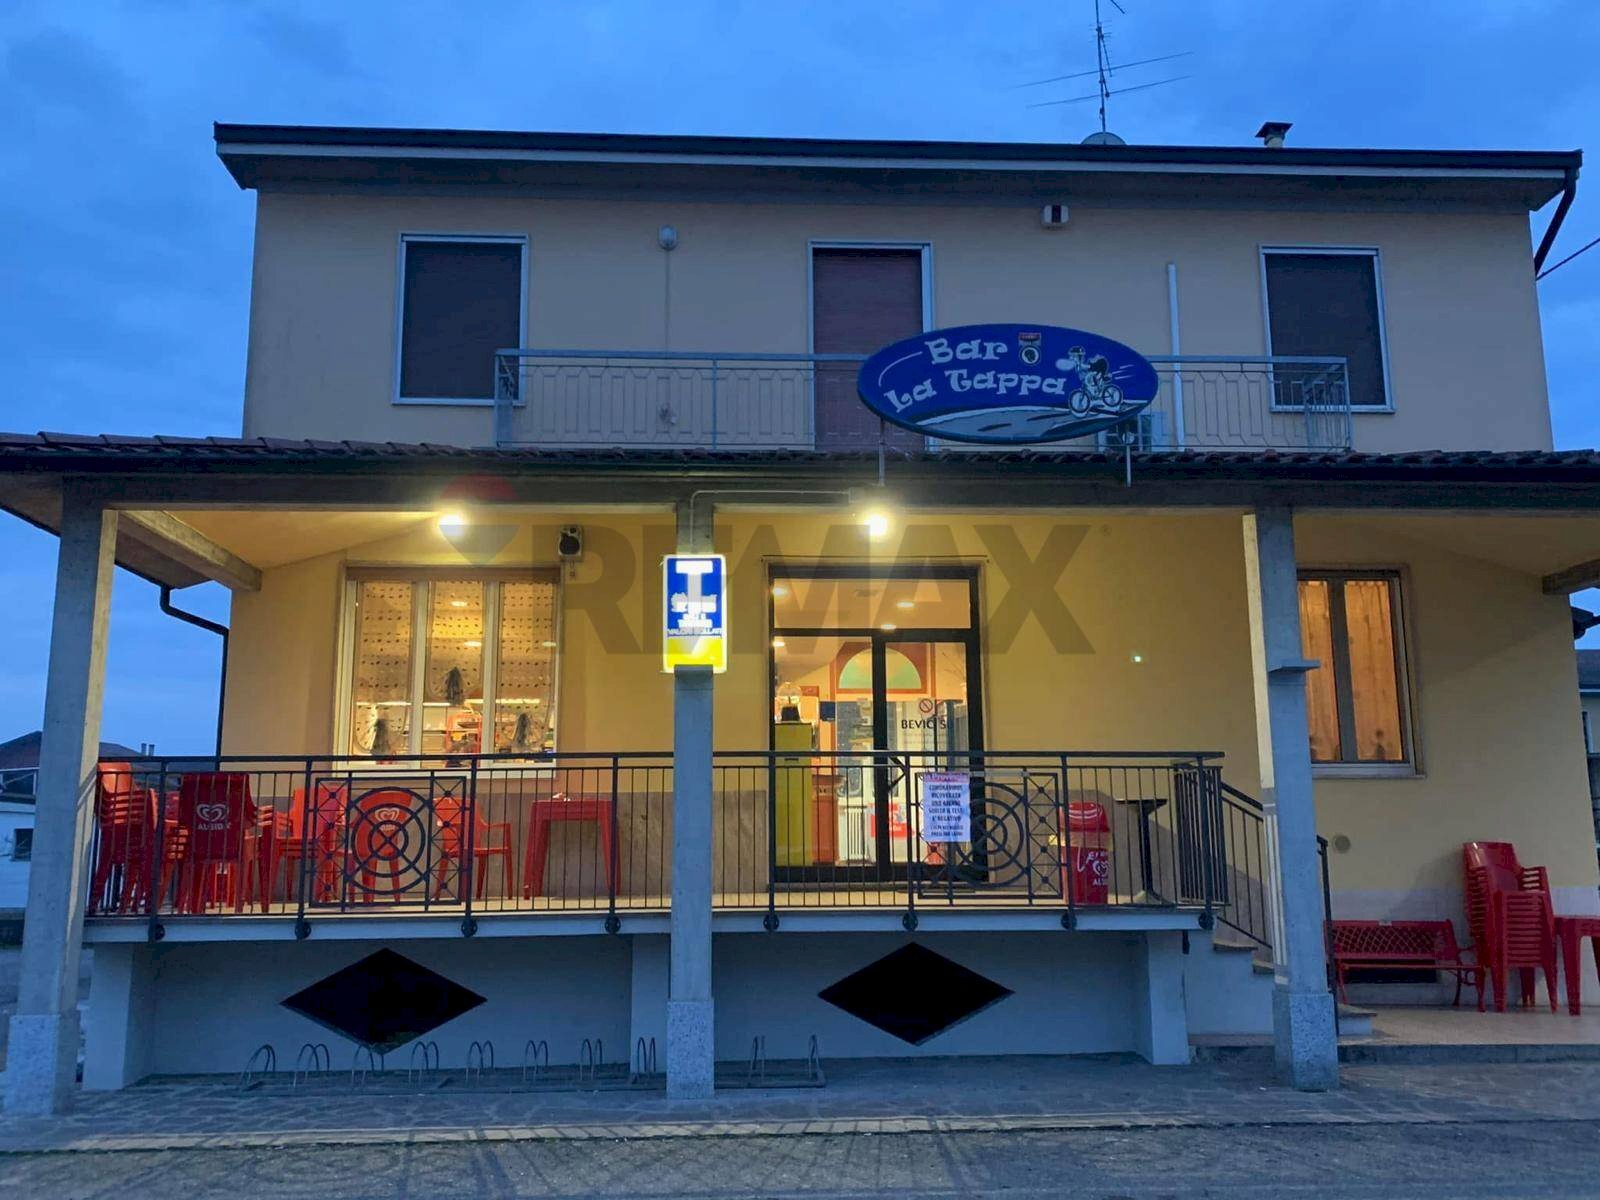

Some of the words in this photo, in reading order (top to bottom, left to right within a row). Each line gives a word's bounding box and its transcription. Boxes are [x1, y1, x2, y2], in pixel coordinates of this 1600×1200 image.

[924, 337, 1009, 365] Bar
[882, 378, 937, 413] La
[944, 367, 1067, 395] Tappa
